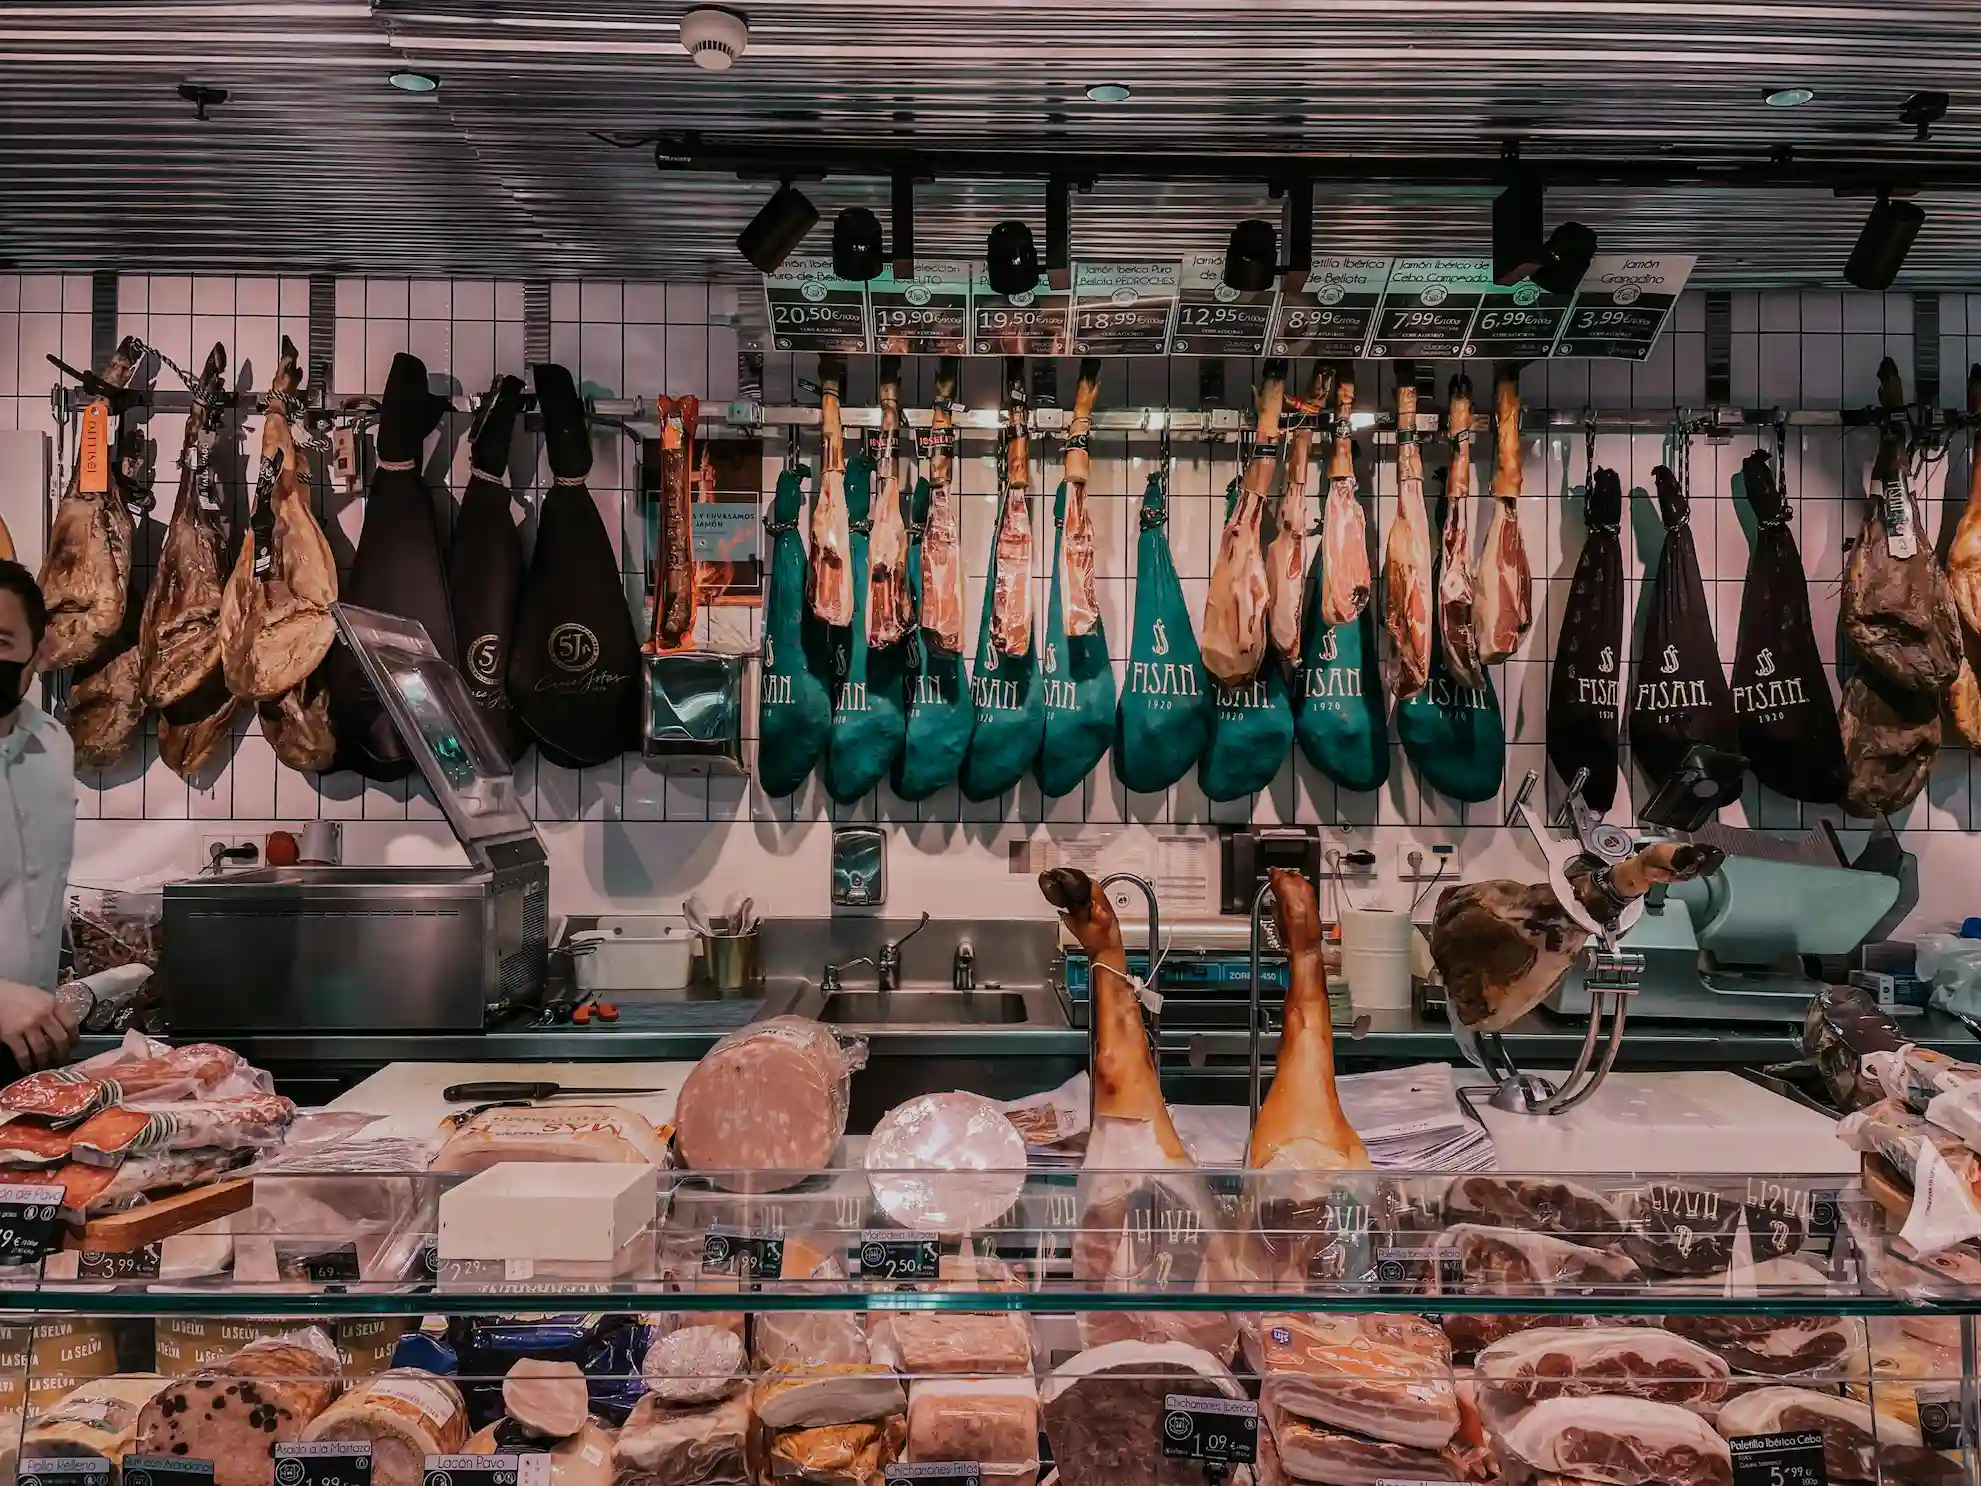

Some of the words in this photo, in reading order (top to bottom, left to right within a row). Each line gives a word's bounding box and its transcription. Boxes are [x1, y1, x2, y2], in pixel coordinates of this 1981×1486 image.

[914, 264, 961, 274] elección
[1085, 265, 1113, 275] Jamón
[1151, 265, 1172, 274] Puro
[1311, 258, 1340, 269] etilla
[1397, 260, 1427, 271] Jamón
[1434, 260, 1471, 269] Ibérico
[1473, 260, 1490, 270] de
[1620, 259, 1660, 270] Jamón
[796, 272, 813, 281] de
[1080, 277, 1113, 285] Bellota
[1200, 270, 1217, 280] de
[1324, 273, 1367, 284] Bellota
[1391, 272, 1424, 283] Cebo
[1599, 272, 1665, 285] Granadino
[1132, 661, 1198, 696] FISAN
[1635, 680, 1706, 711] FISAN
[1732, 678, 1806, 714] FISAN
[1147, 699, 1173, 710] 1920
[1313, 701, 1341, 712] 1920
[1758, 711, 1785, 724] 1920
[41, 1323, 73, 1338] SELVA
[181, 1320, 205, 1336] SELVA
[222, 1325, 231, 1338] LA
[343, 1325, 353, 1338] LA
[355, 1320, 386, 1336] SELVA
[61, 1349, 73, 1362] LA
[75, 1338, 103, 1359] SELVA
[196, 1349, 204, 1362] LA
[374, 1346, 385, 1360] LA
[2, 1353, 13, 1367] LA
[30, 1378, 41, 1392] LA
[43, 1376, 75, 1390] SELVA
[320, 1444, 327, 1454] la
[330, 1442, 371, 1454] Mostaza
[1730, 1439, 1764, 1451] Paletilla
[1765, 1436, 1796, 1448] Ibérica
[1797, 1433, 1822, 1445] Cebo
[27, 1459, 54, 1473] Pollo
[437, 1455, 473, 1469] Lacón
[476, 1455, 505, 1469] Pavo
[887, 1464, 952, 1477] Chicharrones
